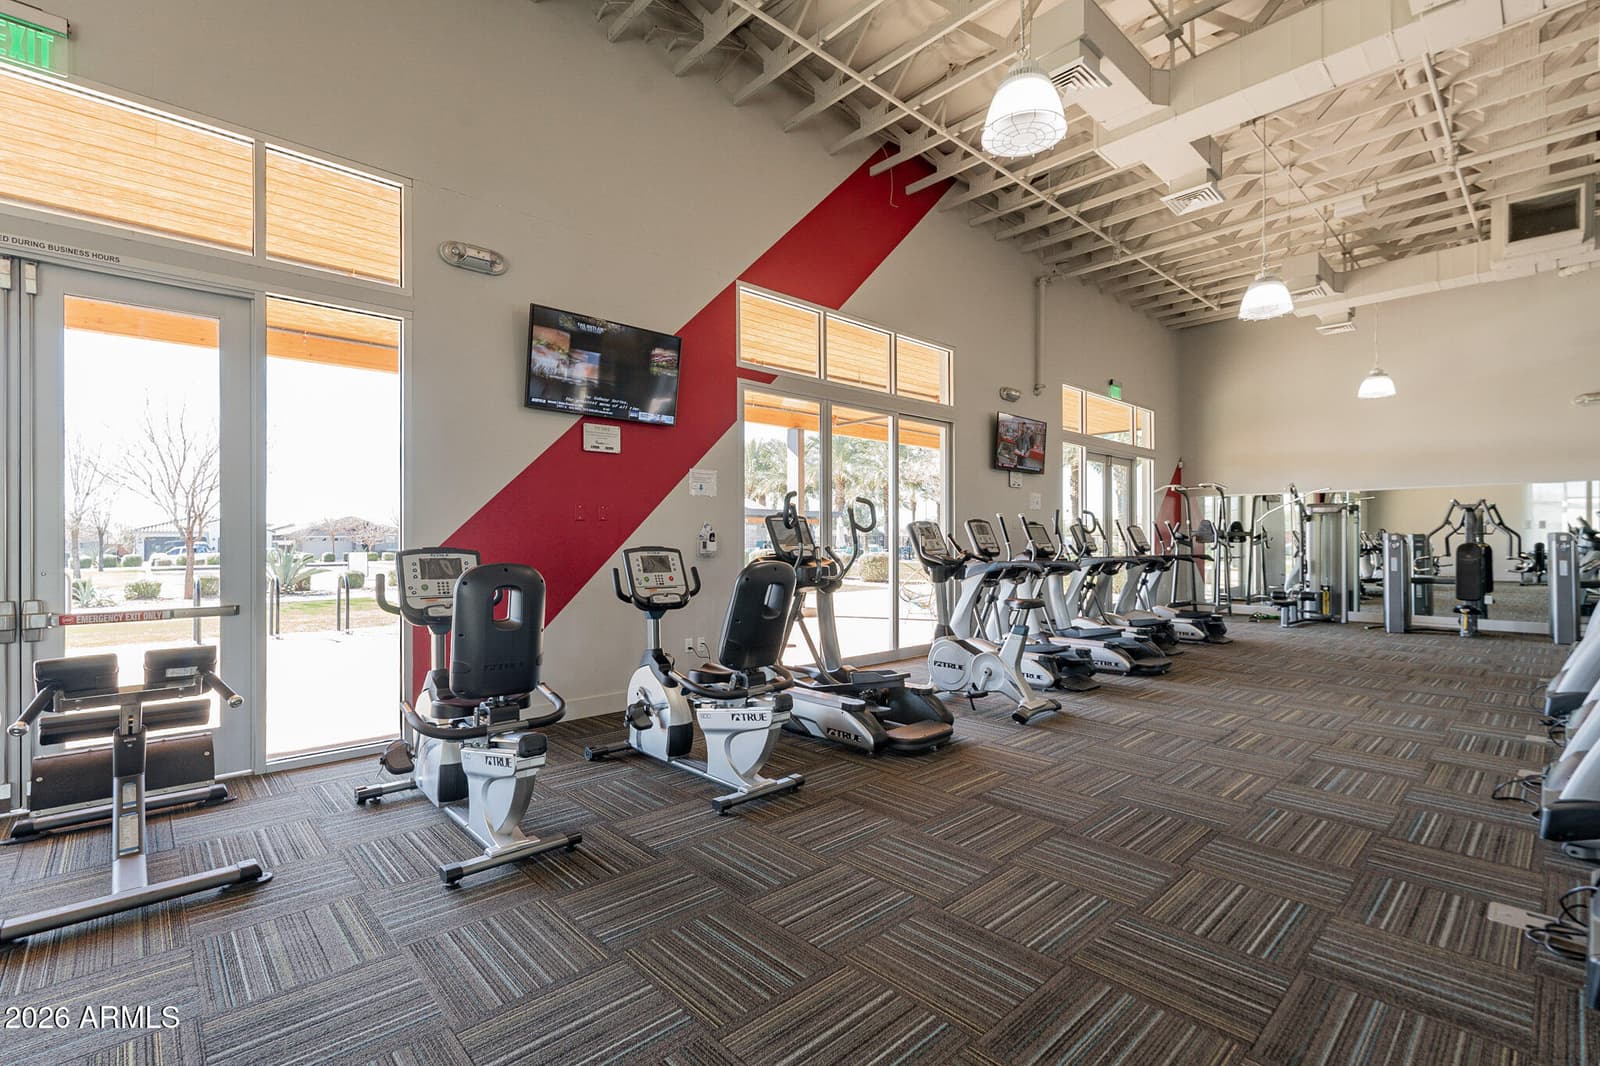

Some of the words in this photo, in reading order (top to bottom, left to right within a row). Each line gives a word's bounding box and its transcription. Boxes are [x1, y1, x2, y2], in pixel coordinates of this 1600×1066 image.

[11, 237, 46, 249] DURING
[47, 244, 90, 257] BUSINESS
[91, 252, 121, 263] HOURS
[76, 614, 123, 624] EMERGENCY
[125, 612, 141, 621] EXIT
[143, 611, 162, 620] ONLY
[943, 662, 965, 670] TRUE
[742, 713, 767, 721] TRUE
[836, 730, 862, 743] TRUE
[492, 756, 512, 768] TRUE
